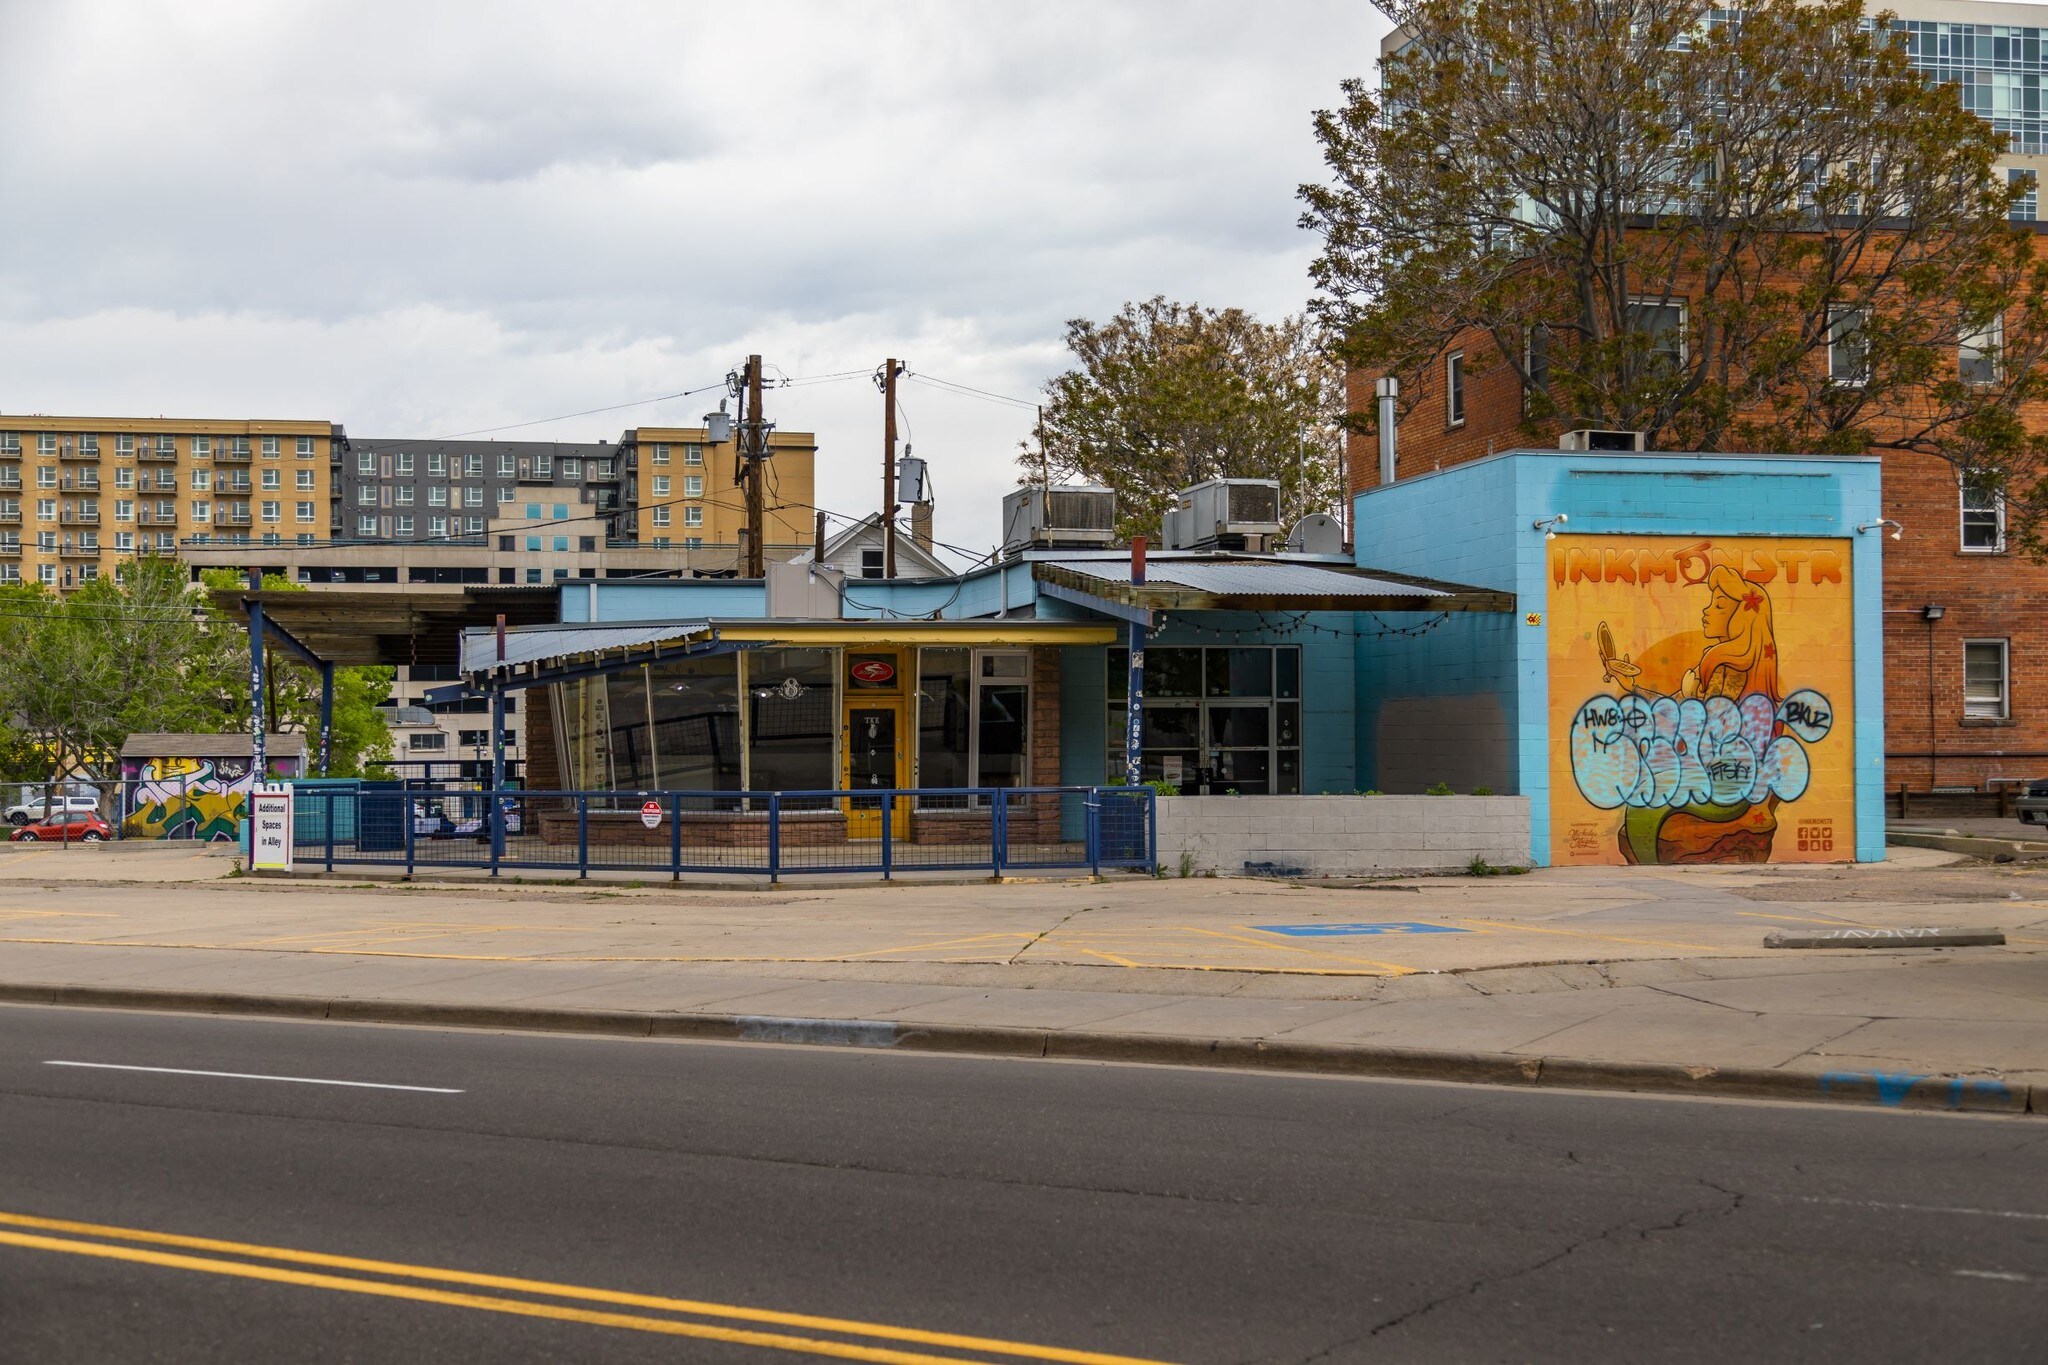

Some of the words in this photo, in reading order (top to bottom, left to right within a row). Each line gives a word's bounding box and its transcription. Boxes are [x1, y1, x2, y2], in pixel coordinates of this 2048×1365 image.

[258, 803, 286, 813] Additional
[262, 820, 282, 832] Spaces
[262, 837, 267, 845] in
[268, 836, 282, 848] Alley
